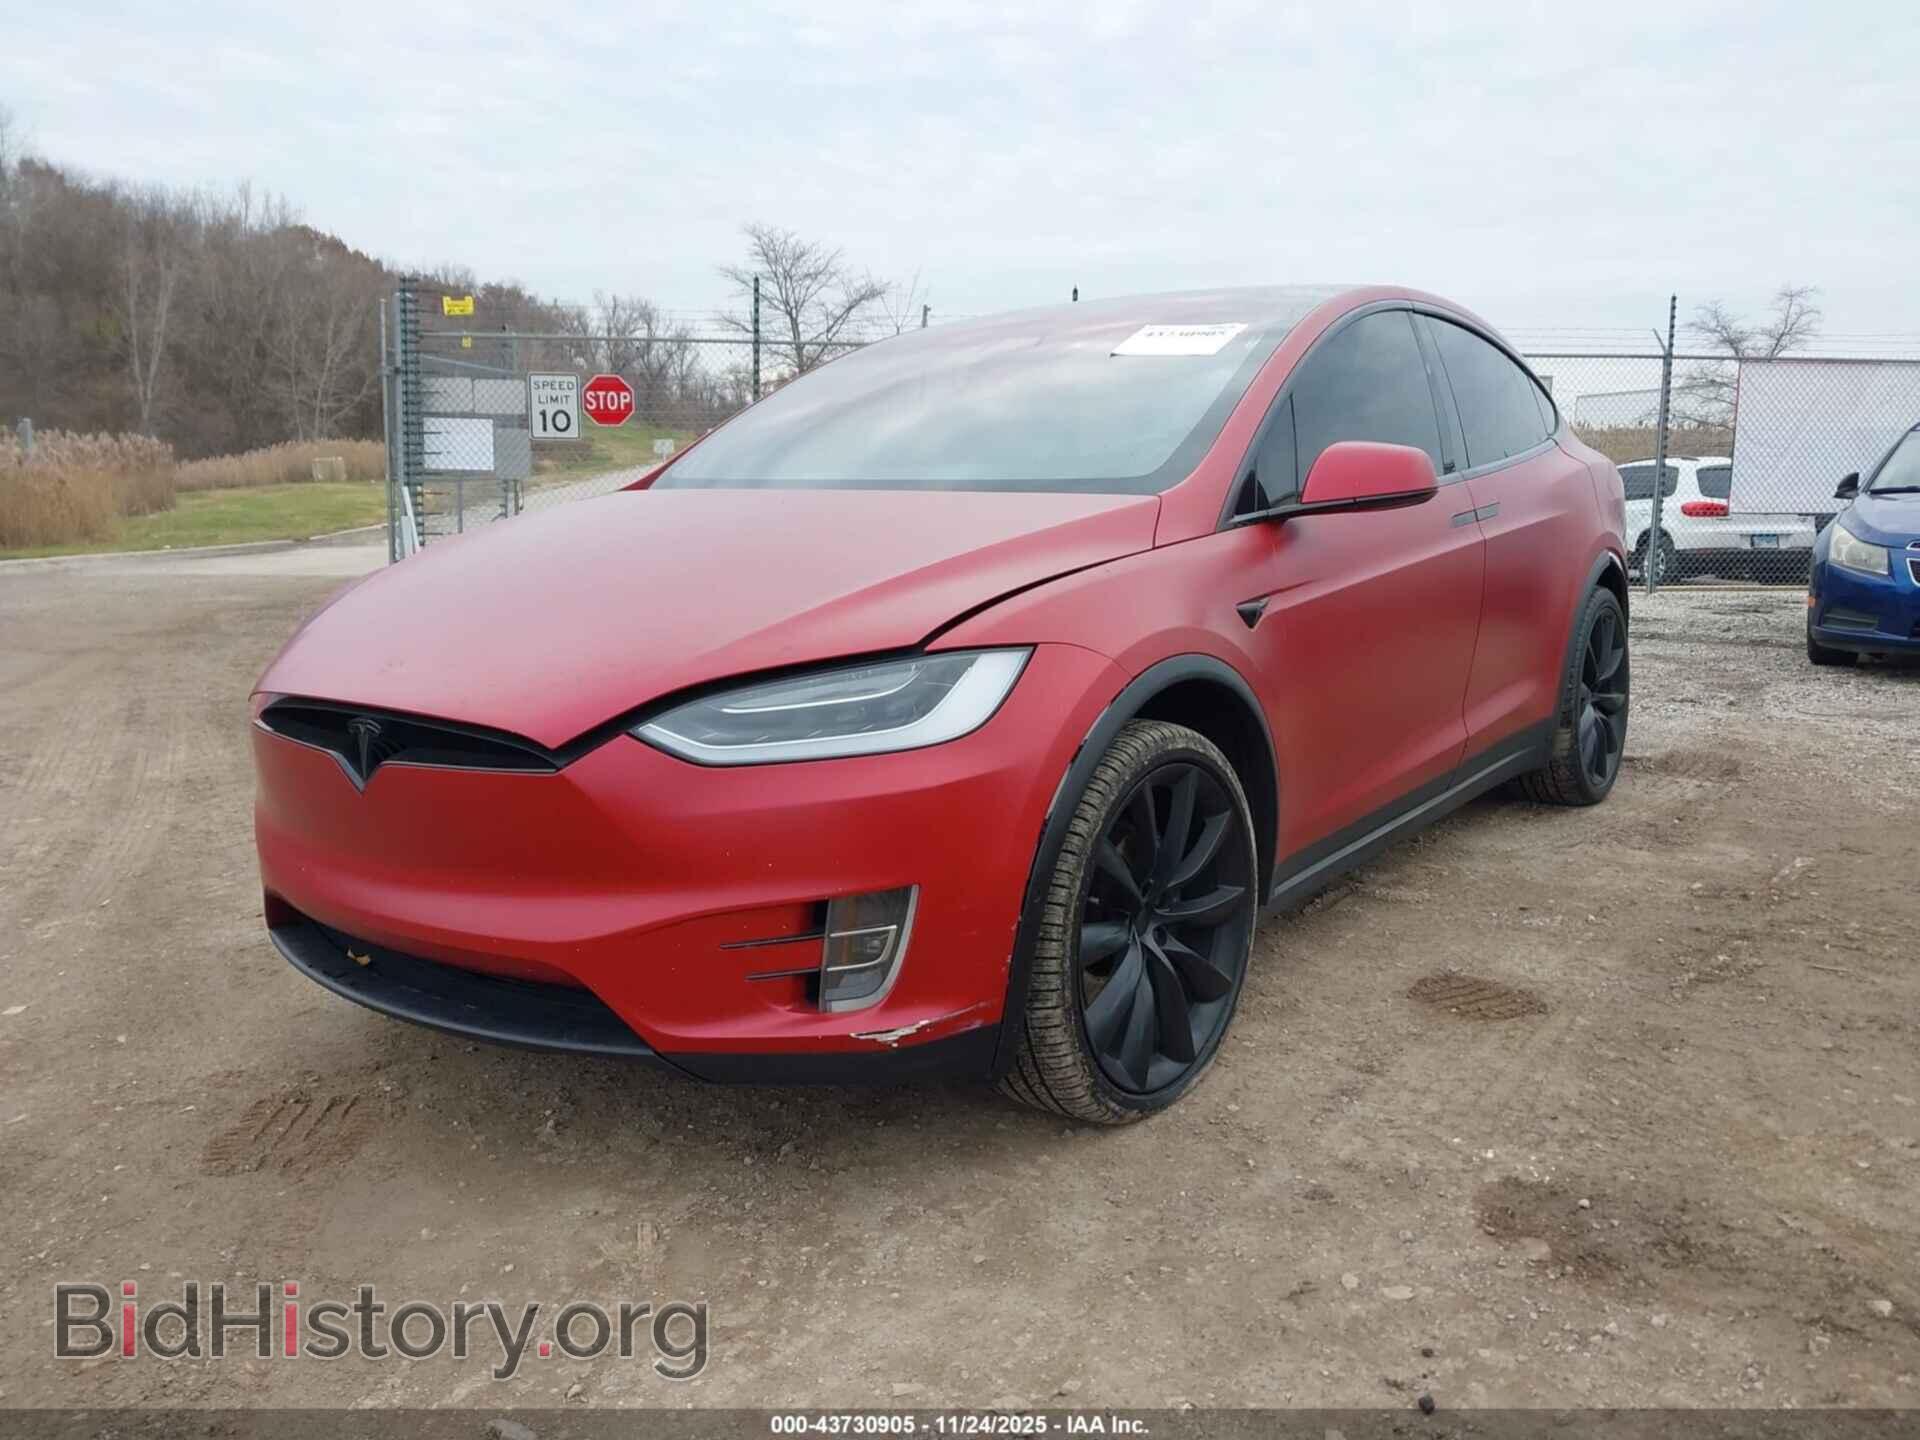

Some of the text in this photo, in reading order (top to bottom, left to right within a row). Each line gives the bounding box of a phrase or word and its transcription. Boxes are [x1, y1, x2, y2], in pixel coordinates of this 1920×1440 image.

[533, 381, 575, 391] SPEED
[538, 395, 570, 405] LIMIT
[586, 391, 630, 410] STOP
[539, 409, 571, 432] 10
